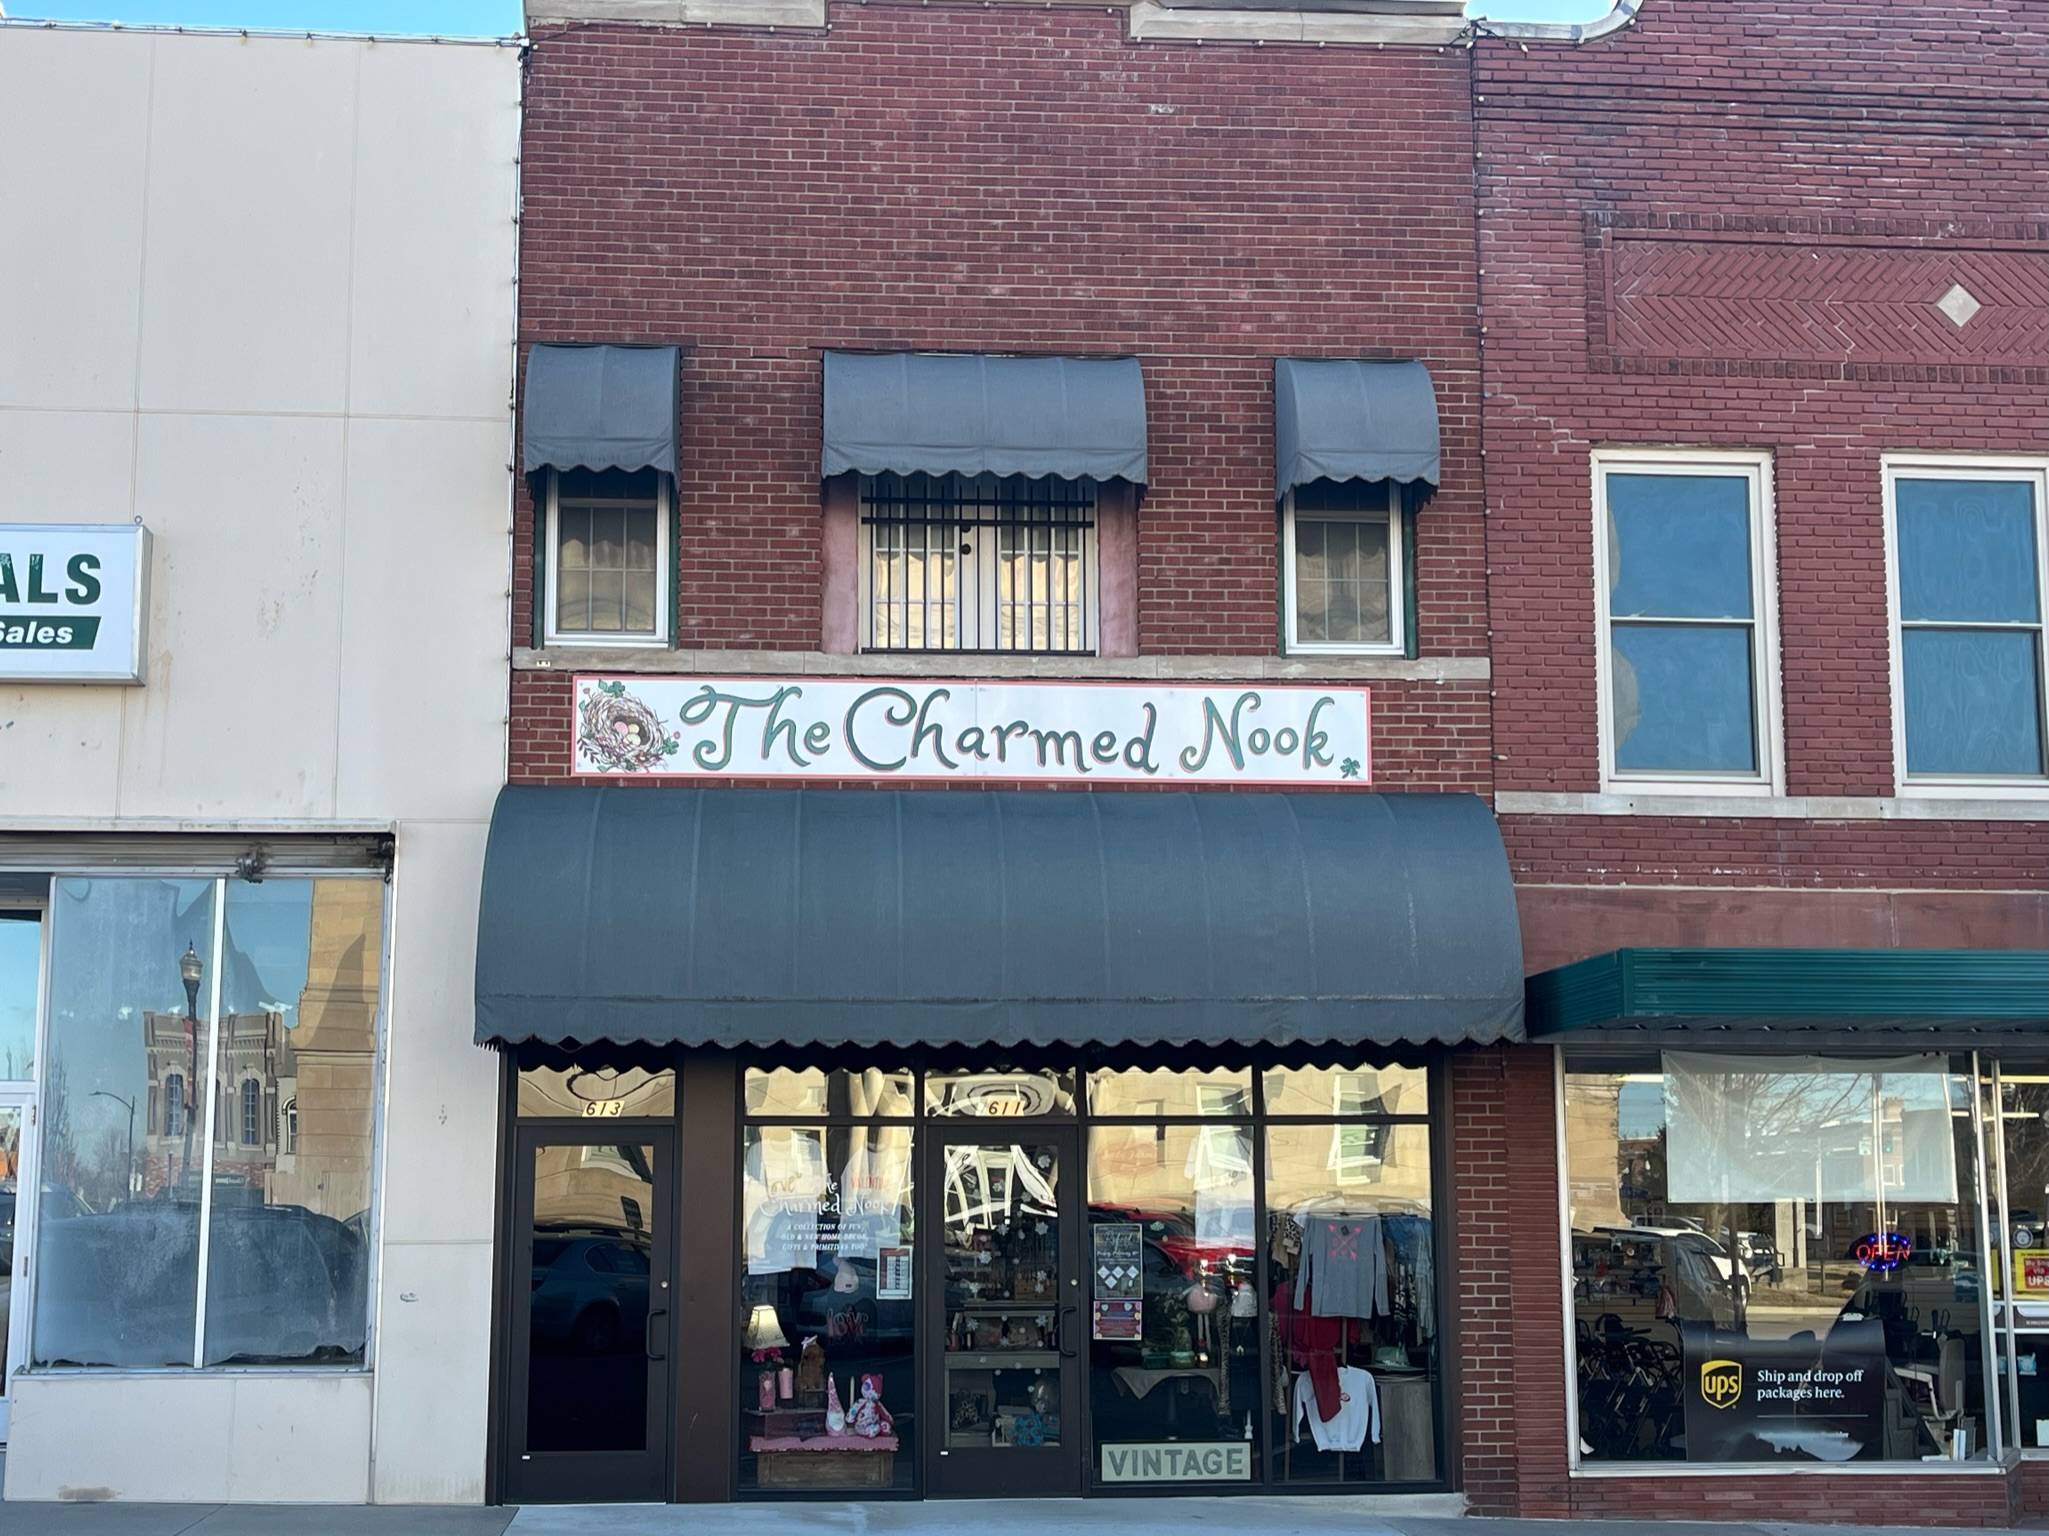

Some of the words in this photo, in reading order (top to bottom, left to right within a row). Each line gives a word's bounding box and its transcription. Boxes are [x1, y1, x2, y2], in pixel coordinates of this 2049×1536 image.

[0, 621, 73, 644] ales
[679, 685, 831, 771] The
[843, 687, 1160, 775] Charmed
[1179, 691, 1336, 773] Nook
[586, 1102, 621, 1116] 613
[988, 1101, 1021, 1115] 611
[760, 1193, 842, 1217] Charmed
[846, 1189, 889, 1217] Nook
[794, 1223, 837, 1231] COLLECTION
[1855, 1243, 1912, 1262] OPEN
[2028, 1275, 2049, 1287] UPS
[1757, 1370, 1786, 1385] Ship
[1787, 1370, 1811, 1382] and
[1814, 1370, 1843, 1385] drop
[1845, 1369, 1865, 1382] off
[1705, 1375, 1738, 1401] ups
[1757, 1386, 1813, 1401] packages
[1815, 1386, 1845, 1399] here.
[1107, 1448, 1243, 1476] VINTAGE
